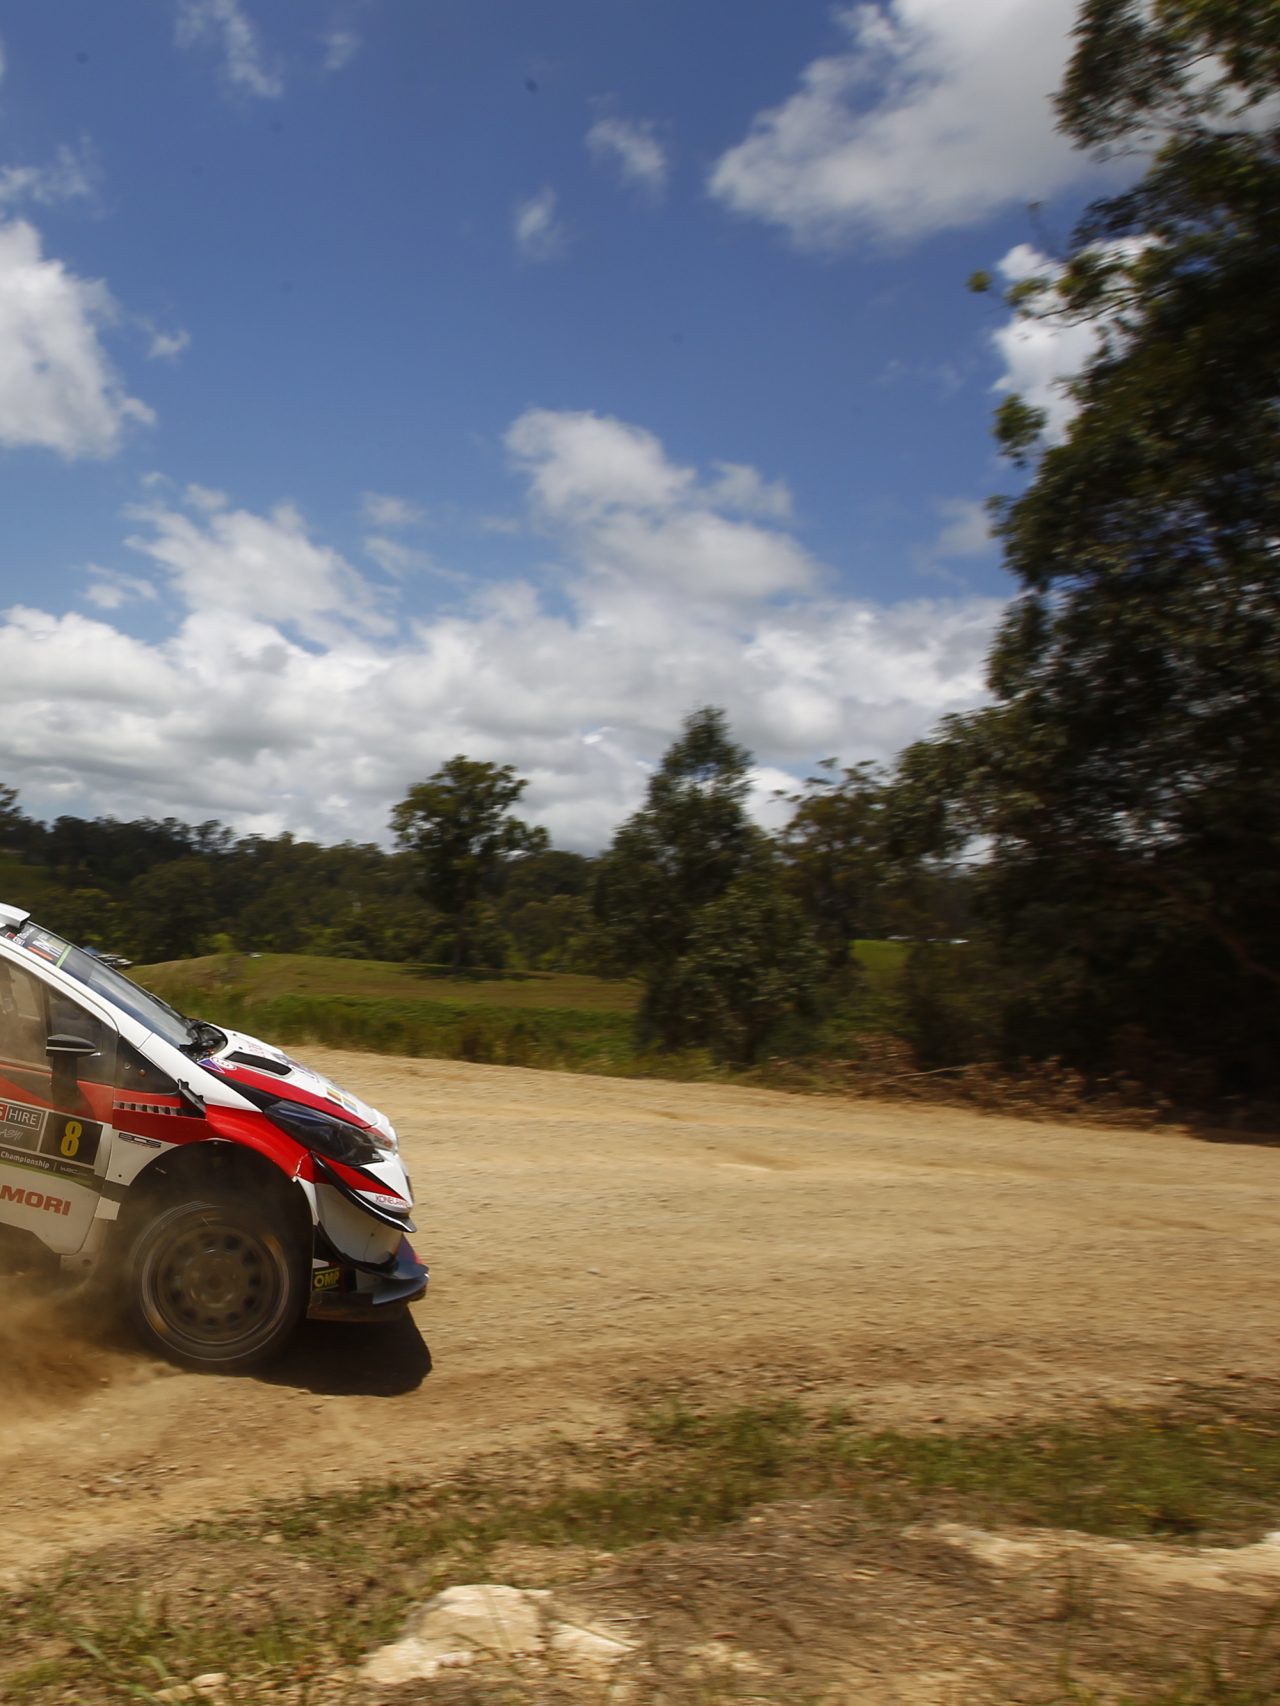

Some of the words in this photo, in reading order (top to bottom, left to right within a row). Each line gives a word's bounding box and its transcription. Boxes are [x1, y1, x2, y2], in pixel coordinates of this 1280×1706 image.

[8, 1110, 39, 1126] HIRE
[60, 1121, 83, 1157] 8
[0, 1150, 50, 1169] Championship
[0, 1184, 72, 1216] MORI
[314, 1273, 340, 1288] OMP
